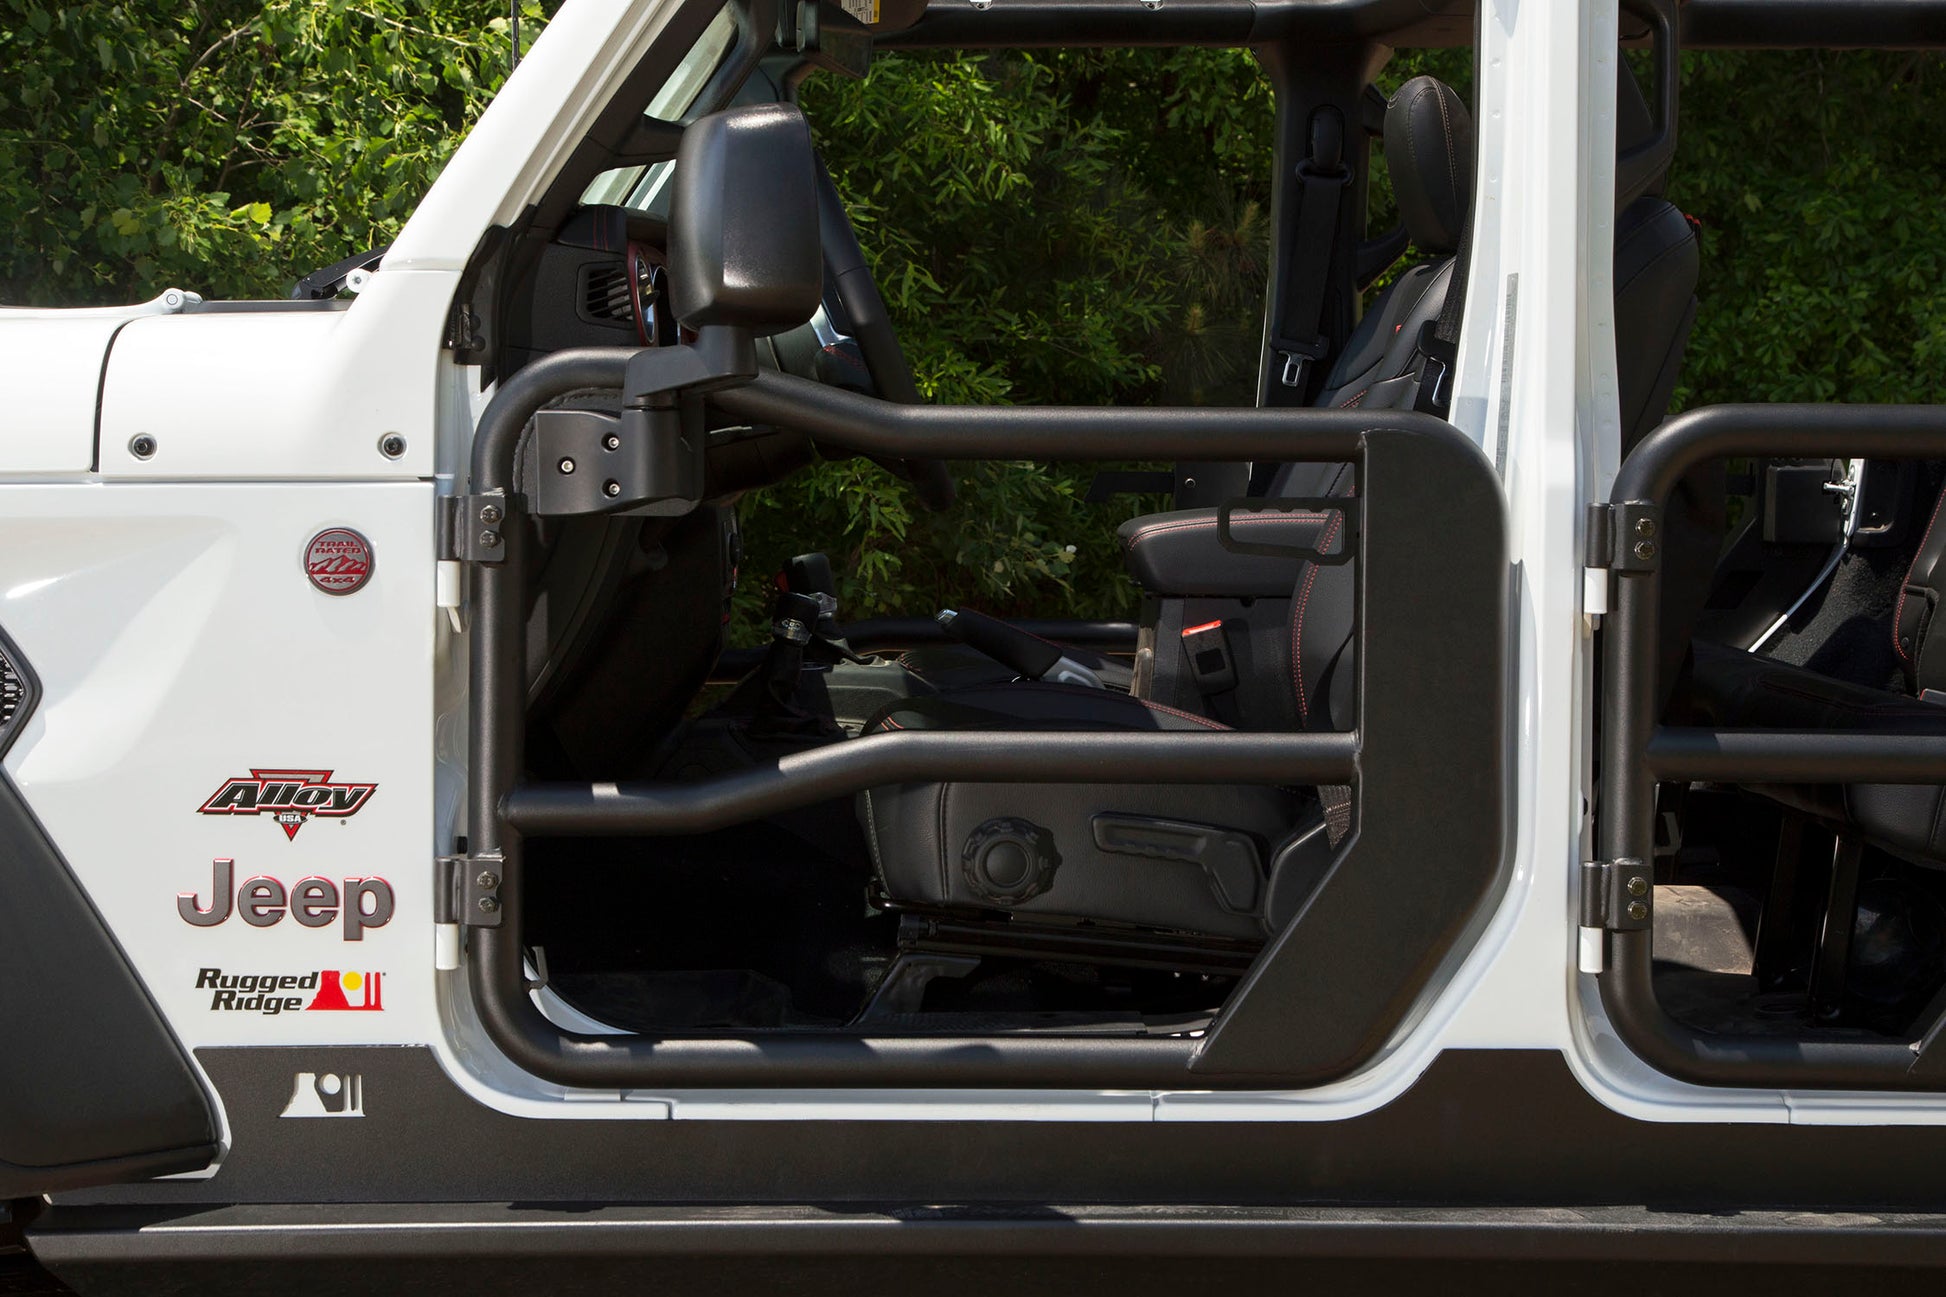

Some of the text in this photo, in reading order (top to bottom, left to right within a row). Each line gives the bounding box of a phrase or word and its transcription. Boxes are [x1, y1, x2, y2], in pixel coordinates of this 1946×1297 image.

[201, 779, 374, 815] Alloy
[278, 813, 301, 823] USA
[177, 858, 396, 942] Jeep
[195, 967, 319, 993] Rugged
[210, 989, 303, 1015] Ridge
